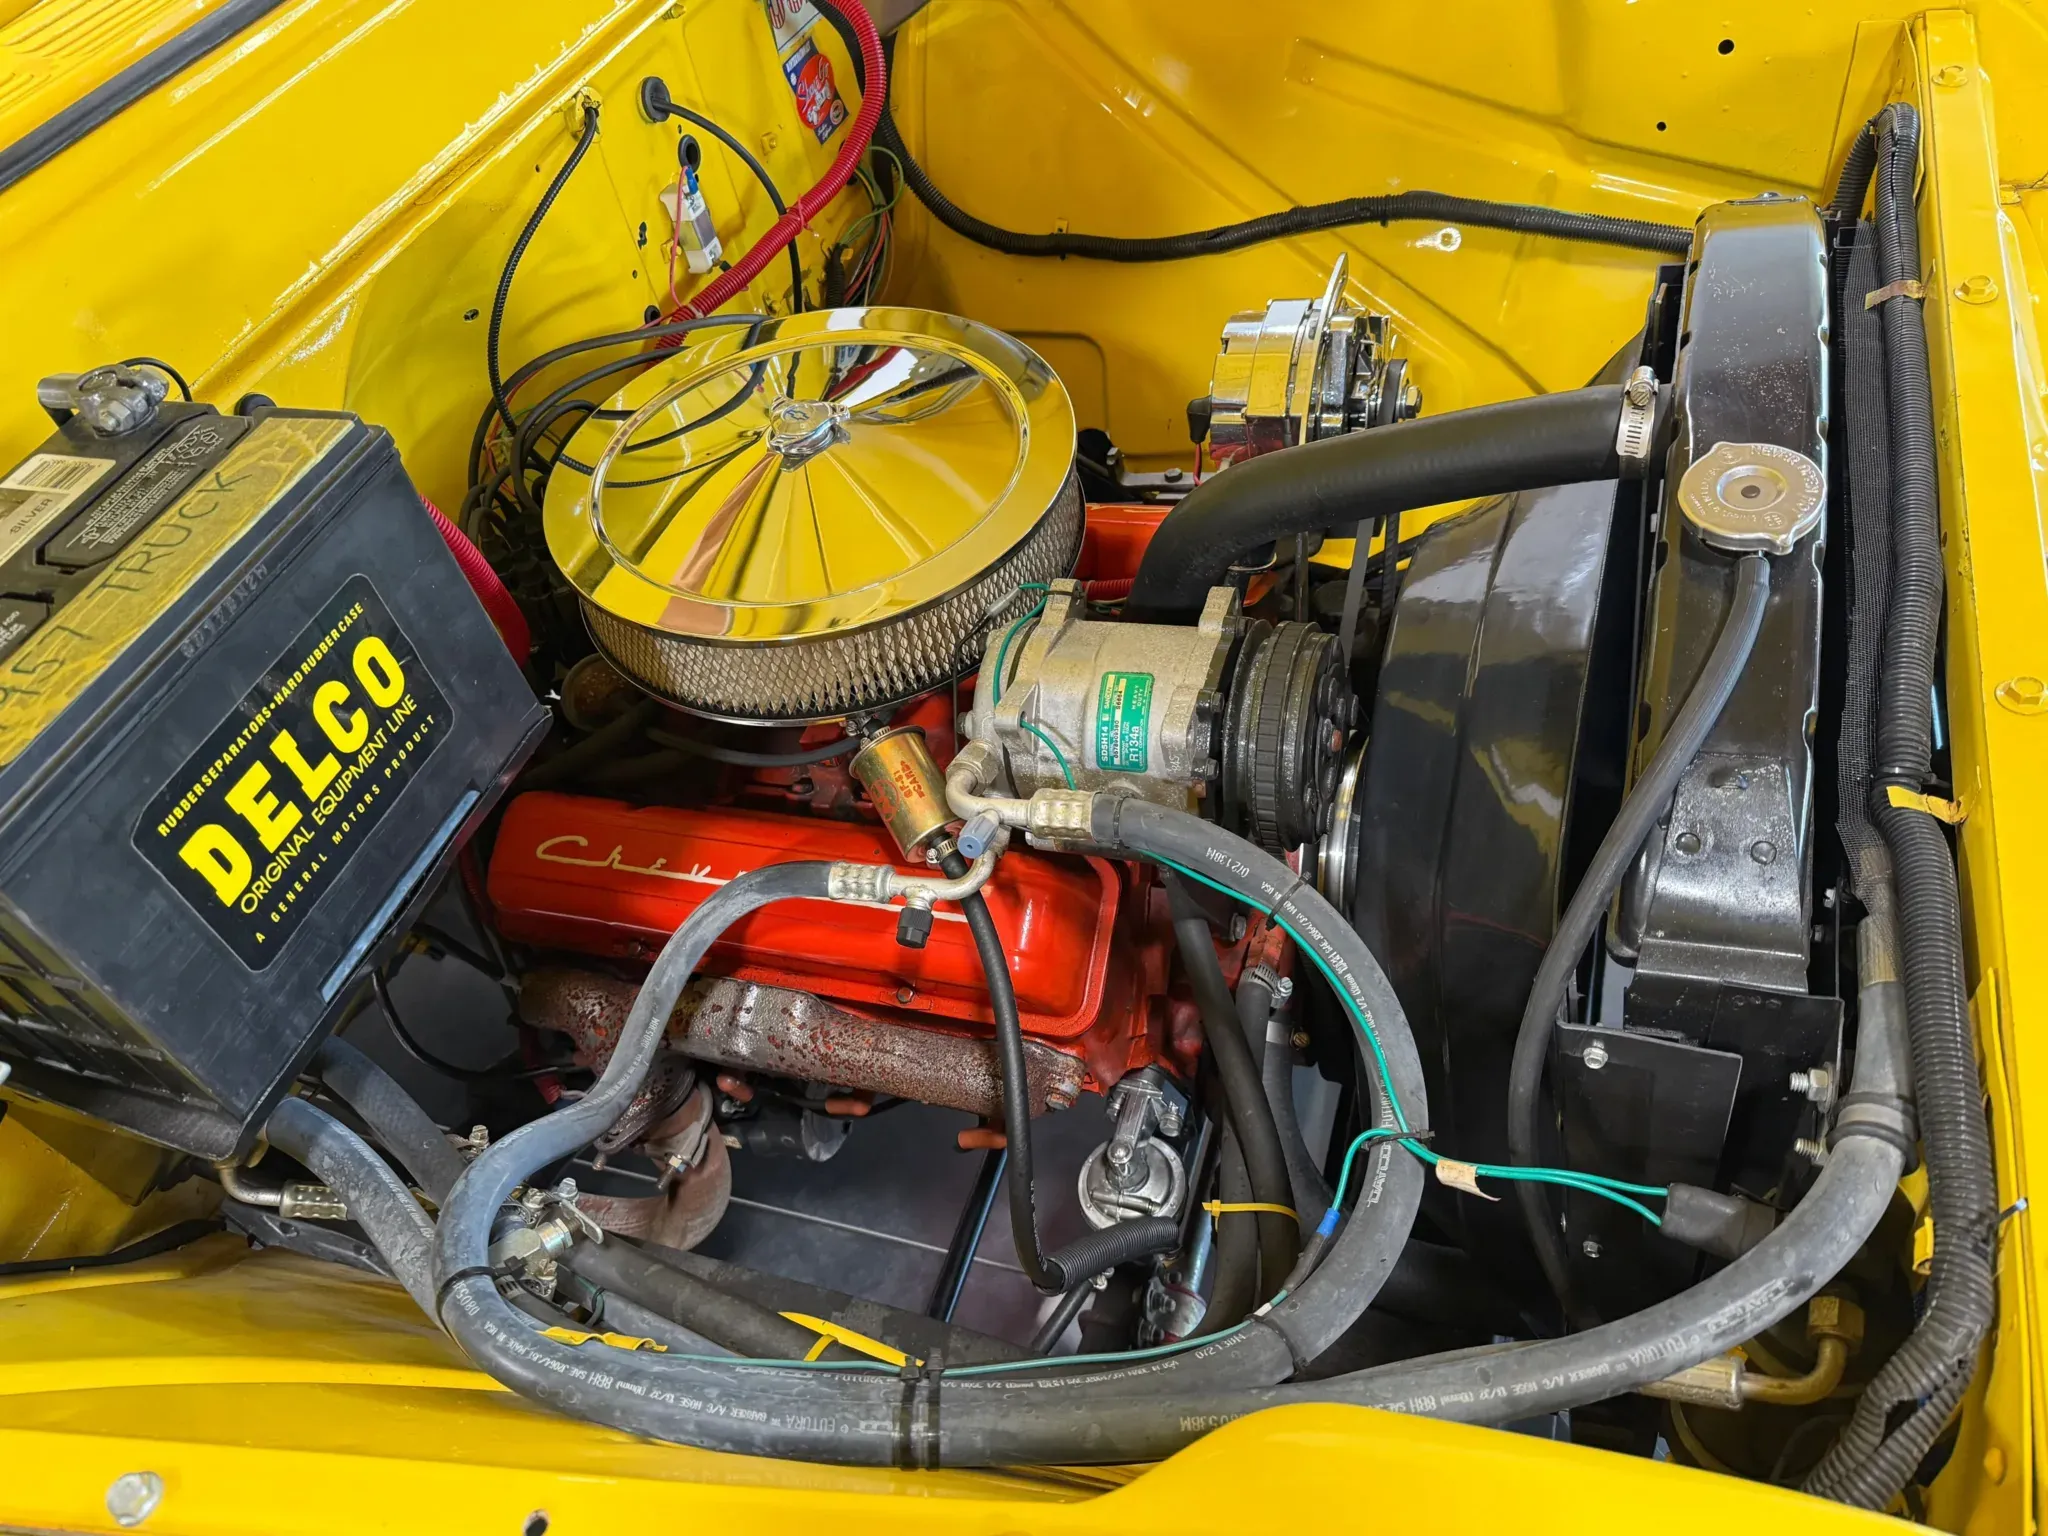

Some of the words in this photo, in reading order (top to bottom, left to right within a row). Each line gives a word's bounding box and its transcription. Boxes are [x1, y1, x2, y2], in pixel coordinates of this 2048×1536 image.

[12, 498, 53, 533] SILVER
[85, 471, 253, 600] TRUCK
[1131, 684, 1139, 710] HEAVY
[158, 783, 204, 837] RUBBER
[301, 628, 341, 674] RUBBER
[338, 602, 364, 634] CASE
[1129, 725, 1140, 762] R134a
[178, 636, 405, 907] DELCO
[240, 826, 315, 914] ORIGINAL
[311, 730, 389, 826] EQUIPMENT
[388, 694, 418, 734] LINE
[256, 932, 266, 943] A
[271, 853, 328, 923] GENERAL
[332, 784, 381, 844] MOTORS
[384, 714, 435, 778] PRODUCT
[1259, 880, 1274, 895] USA
[482, 1320, 499, 1336] USA
[567, 1365, 587, 1380] SAE
[678, 1397, 701, 1410] HOSE
